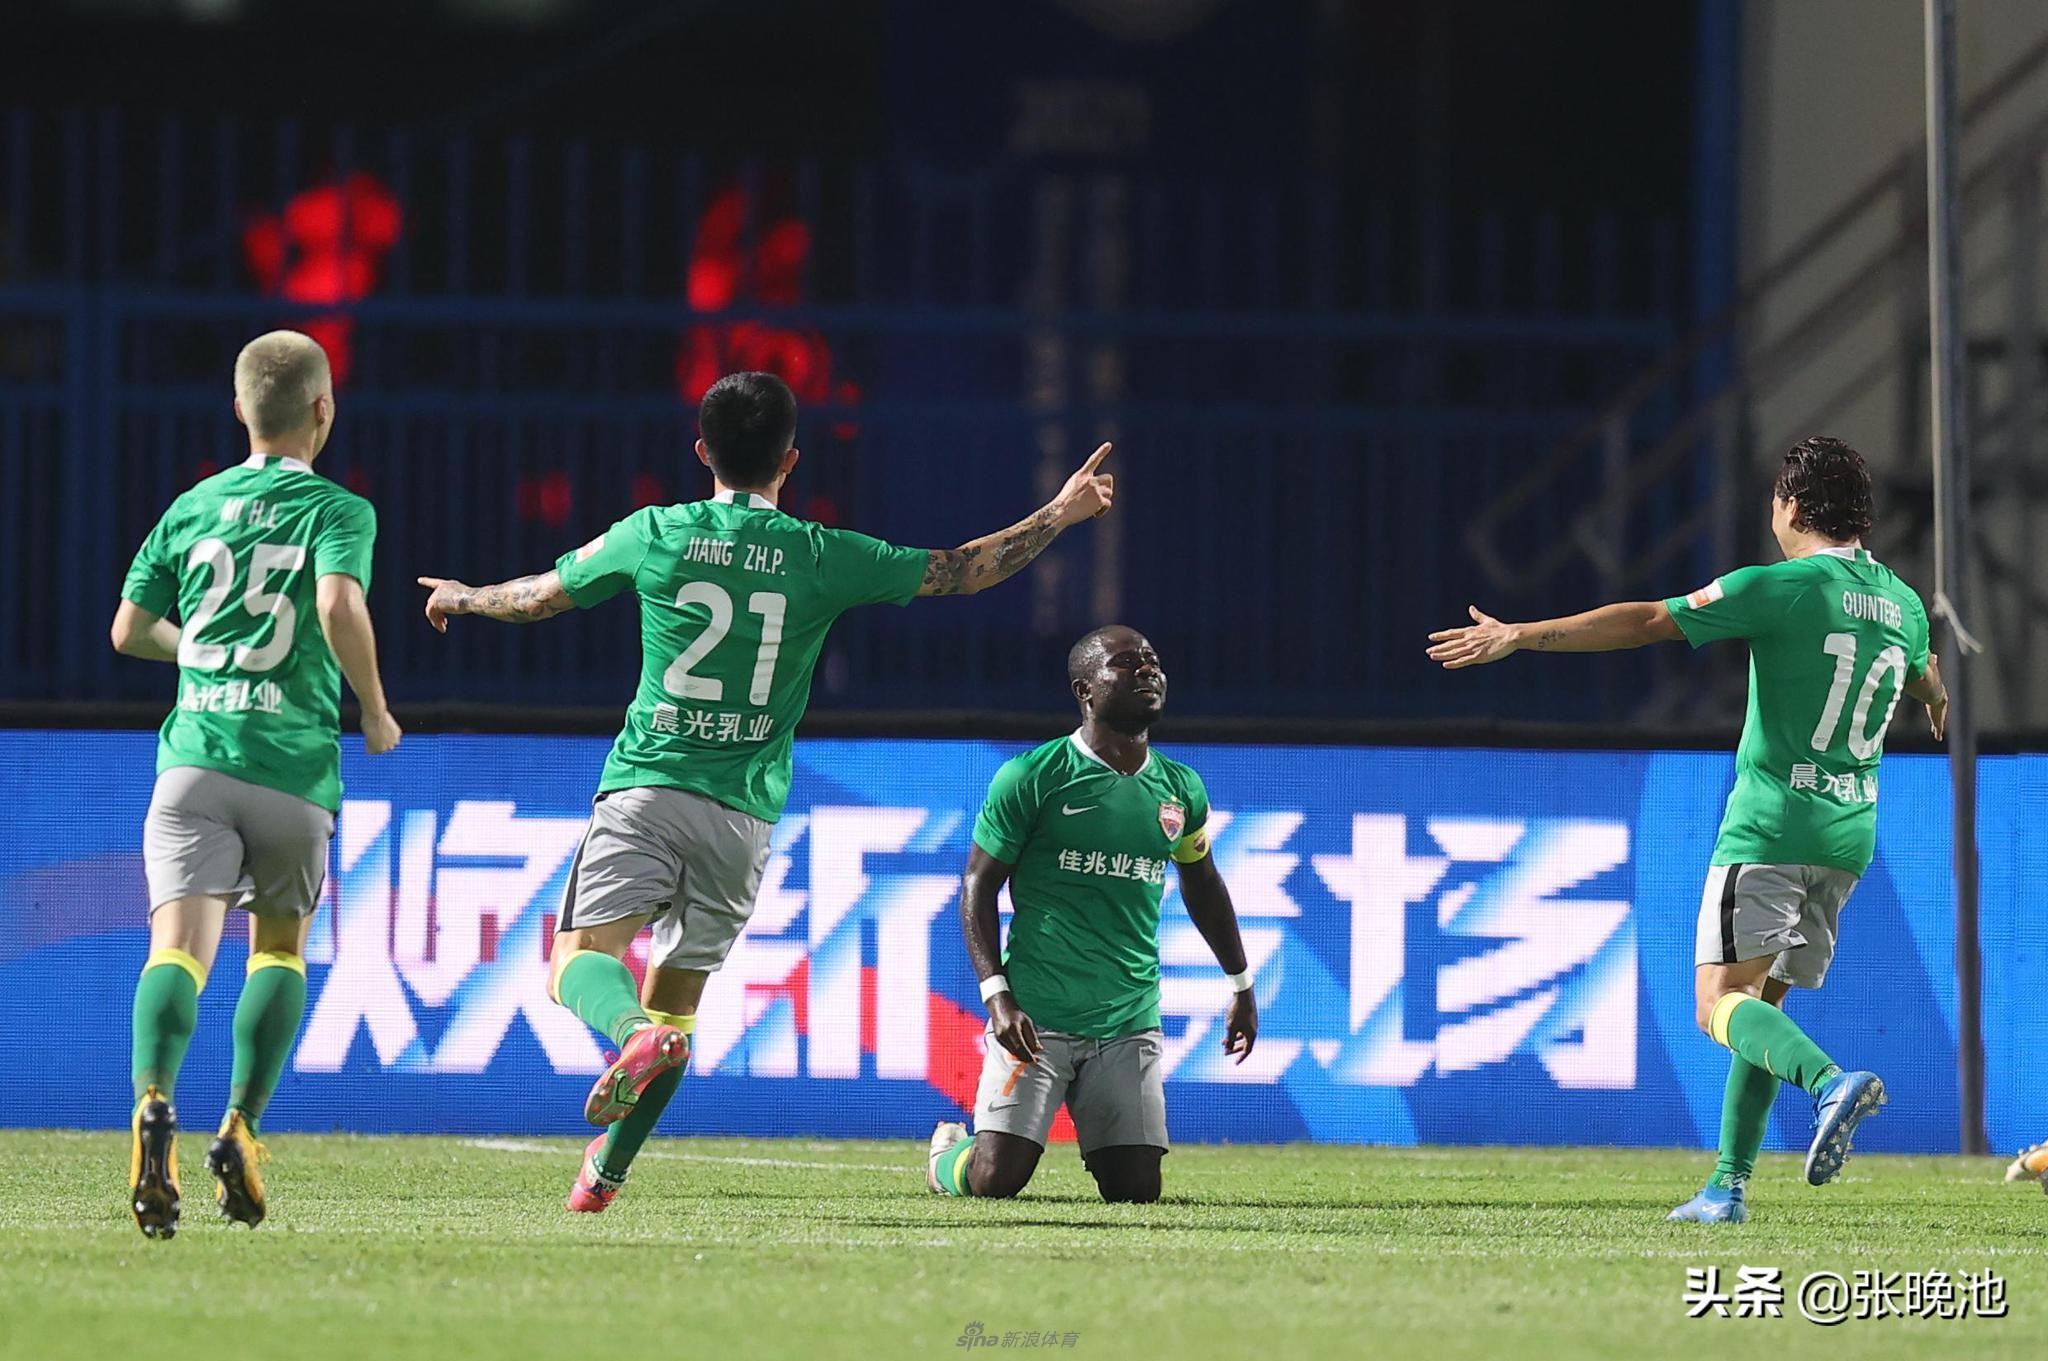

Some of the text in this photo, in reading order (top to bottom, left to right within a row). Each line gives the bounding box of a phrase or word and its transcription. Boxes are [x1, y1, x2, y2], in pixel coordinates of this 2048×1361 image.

[683, 536, 786, 576] JIANG ZH.P.
[177, 537, 306, 673] 25
[663, 581, 787, 706] 21
[1811, 632, 1906, 761] 10
[650, 702, 774, 742] 晨光乳业
[1790, 763, 1878, 803] 晨光乳业
[1058, 848, 1167, 884] 佳兆业美好
